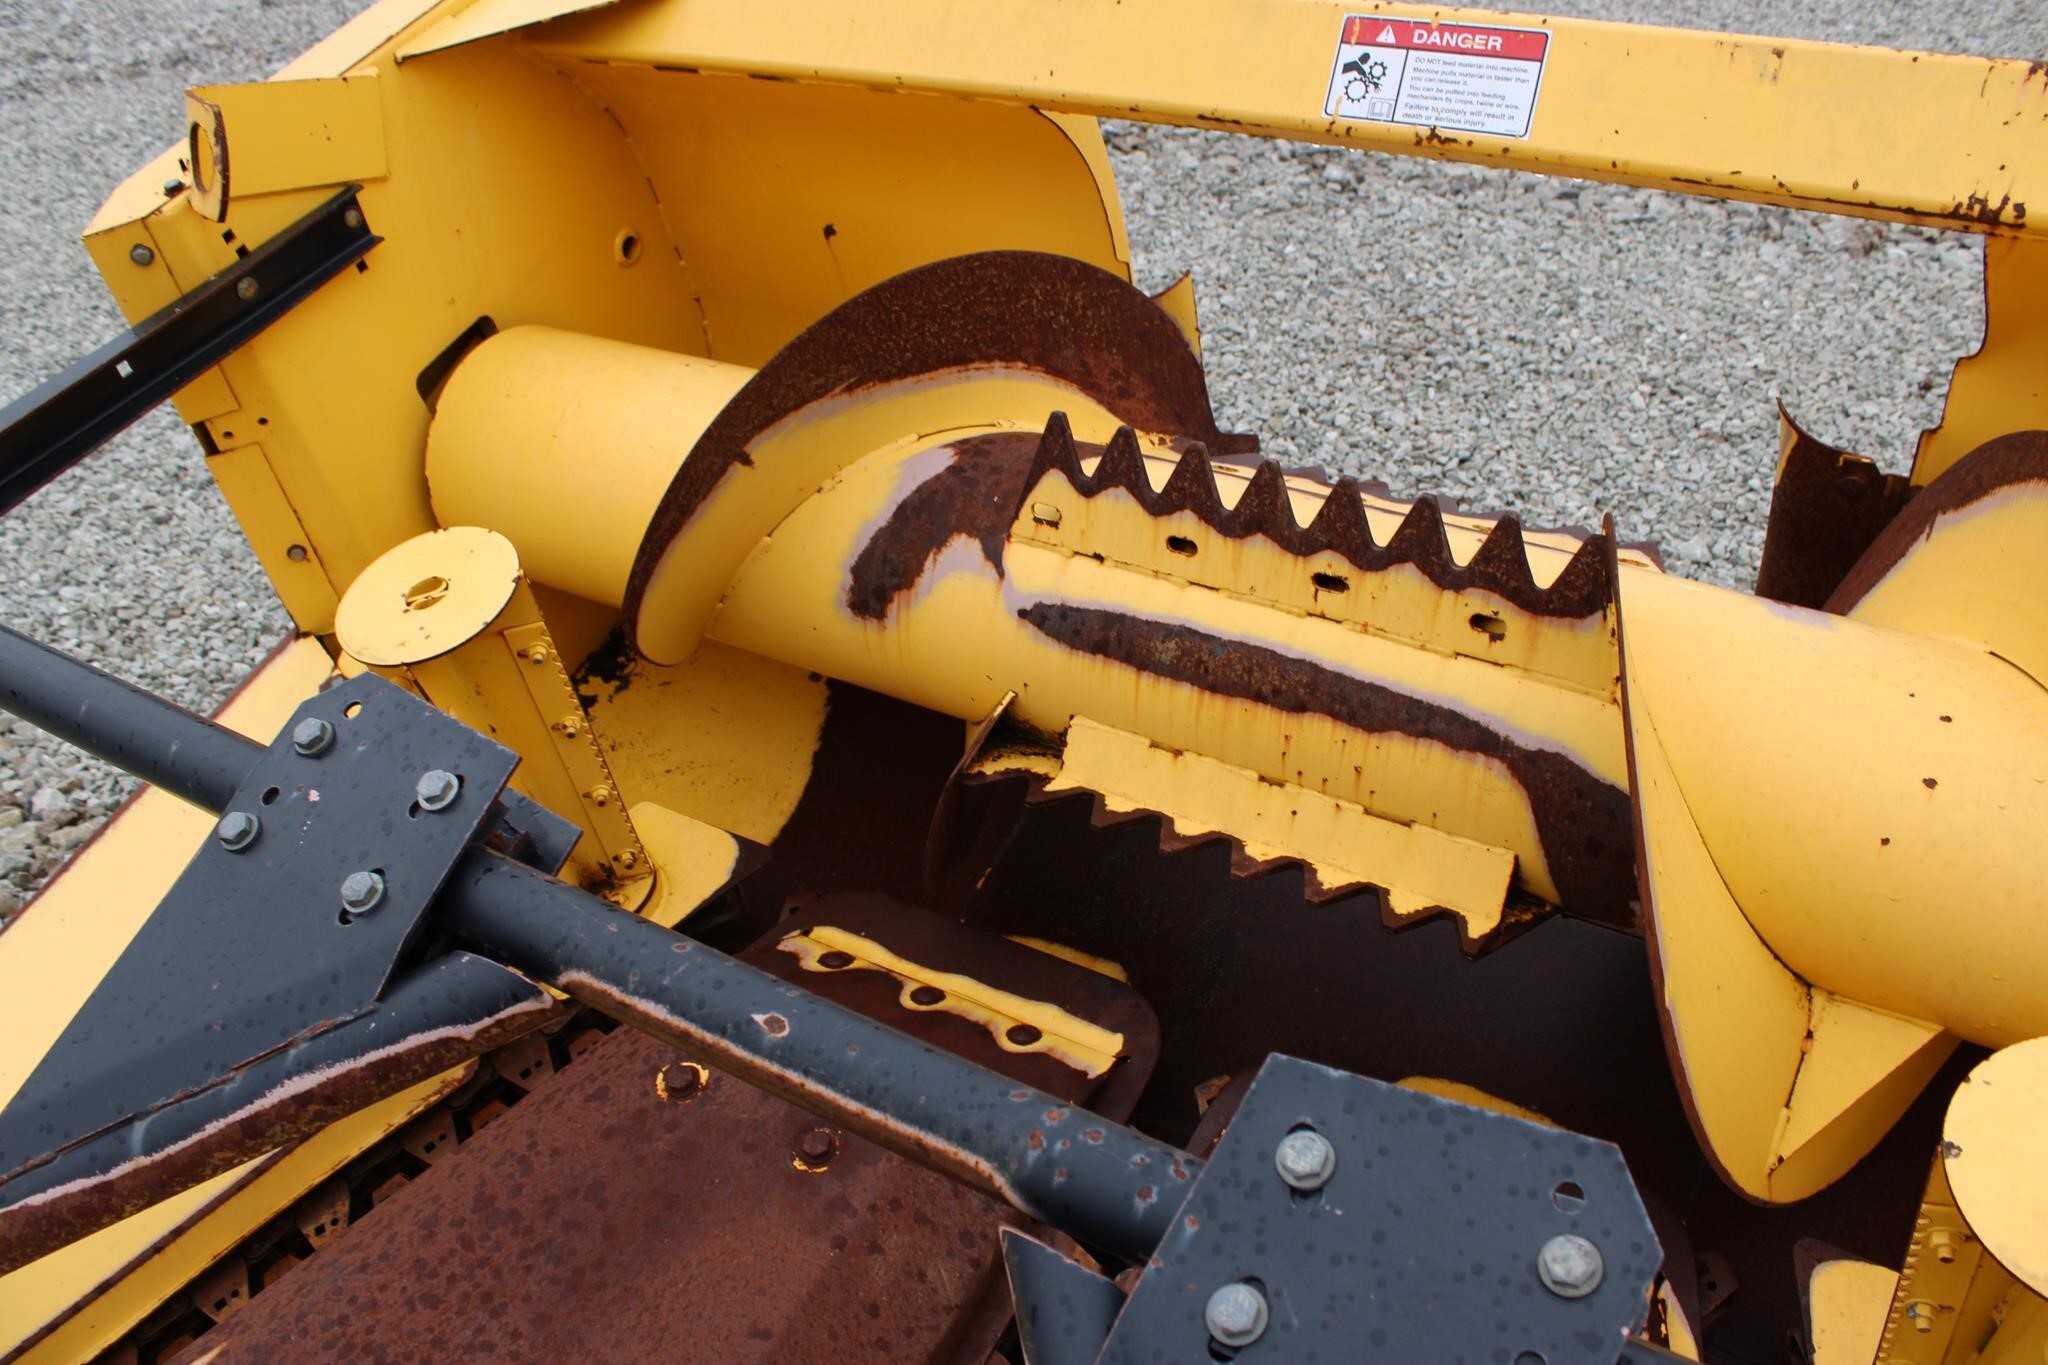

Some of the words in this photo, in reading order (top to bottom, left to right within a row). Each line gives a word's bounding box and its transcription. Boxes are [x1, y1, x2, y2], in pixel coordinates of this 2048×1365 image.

[1412, 28, 1503, 51] DANGER
[1457, 61, 1484, 69] material
[1485, 63, 1498, 71] into
[1413, 66, 1439, 74] Machine
[1458, 71, 1485, 79] material
[1494, 74, 1513, 82] faster
[1407, 93, 1444, 101] mechanism
[1445, 88, 1466, 96] pulled
[1481, 91, 1506, 101] feeding
[1402, 112, 1423, 120] death
[1434, 116, 1461, 124] serious
[1440, 107, 1467, 116] comply
[1484, 112, 1506, 120] result
[1507, 113, 1515, 121] in
